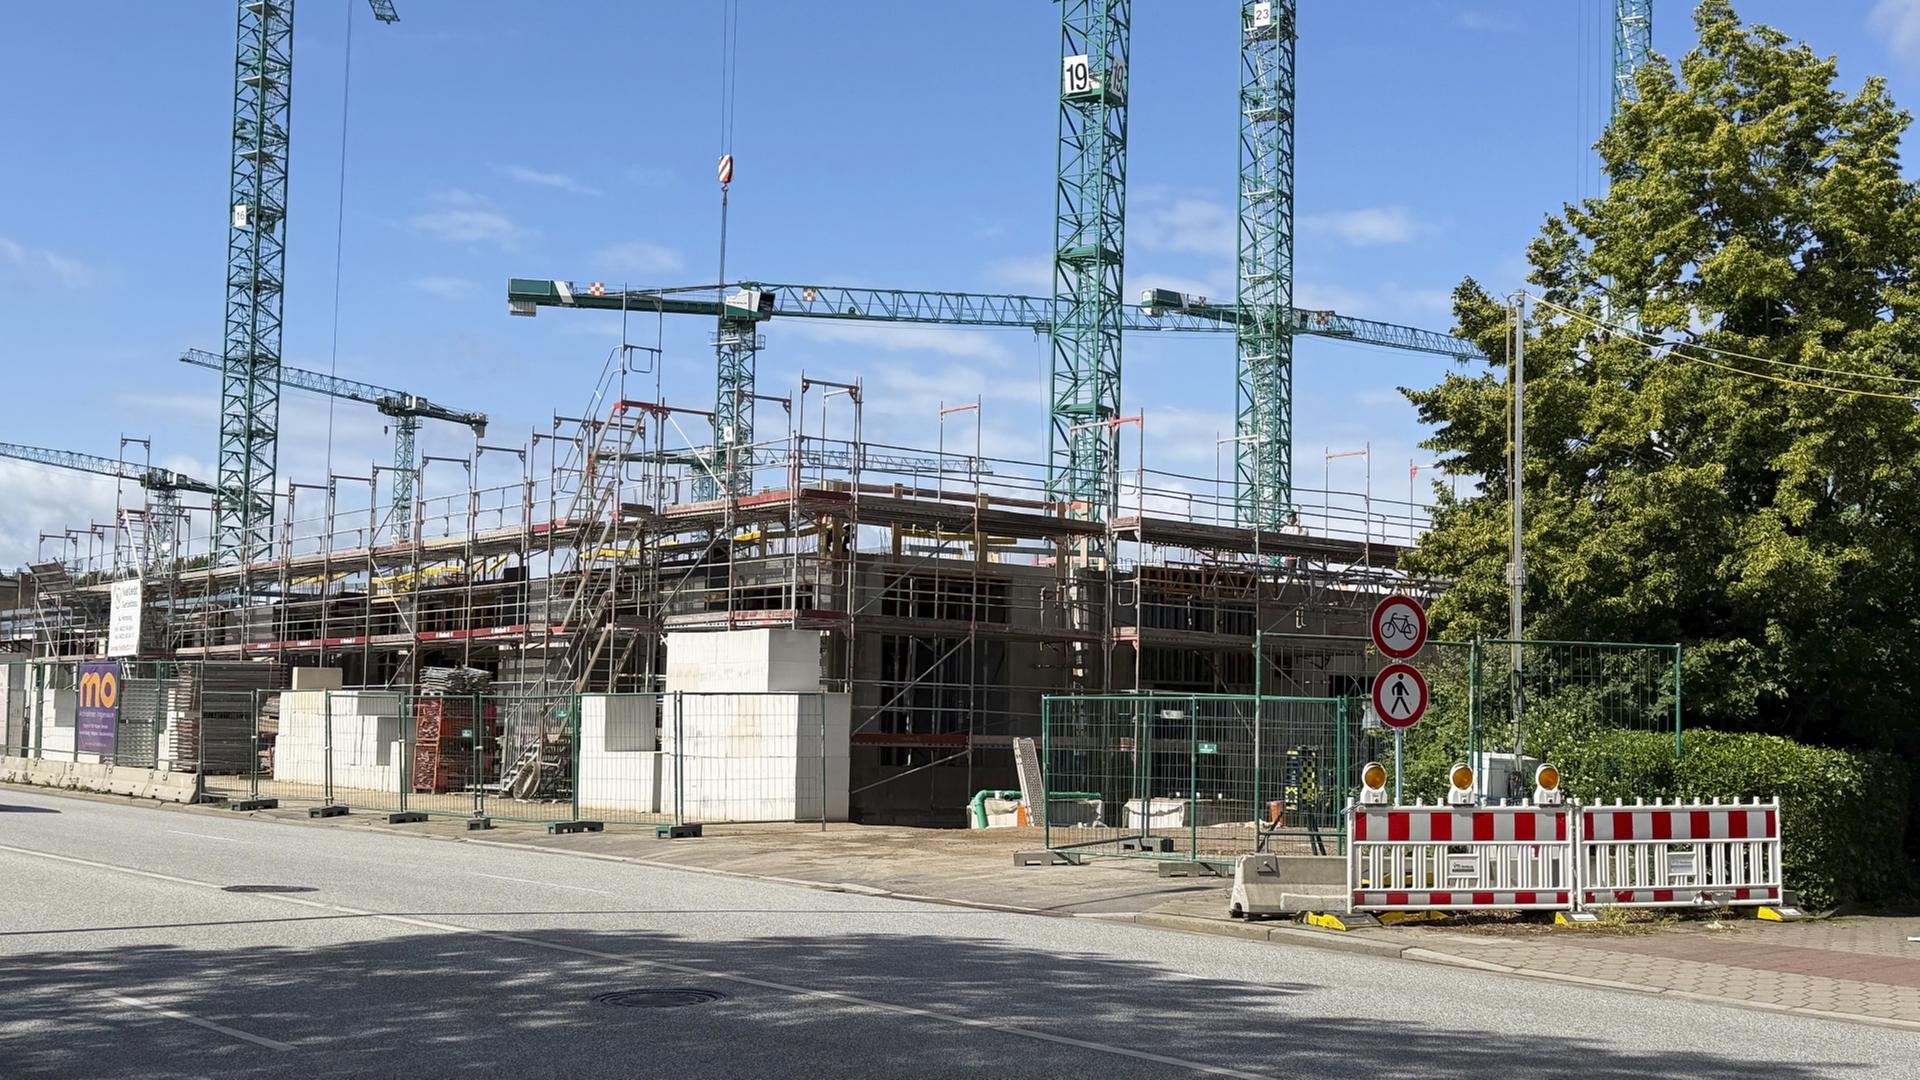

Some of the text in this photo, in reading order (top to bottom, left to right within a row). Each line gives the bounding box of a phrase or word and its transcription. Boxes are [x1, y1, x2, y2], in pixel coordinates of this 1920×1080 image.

[1256, 9, 1269, 20] 23
[1066, 63, 1087, 90] 19
[1114, 63, 1123, 92] 19
[237, 211, 245, 221] 16
[80, 672, 116, 708] mo
